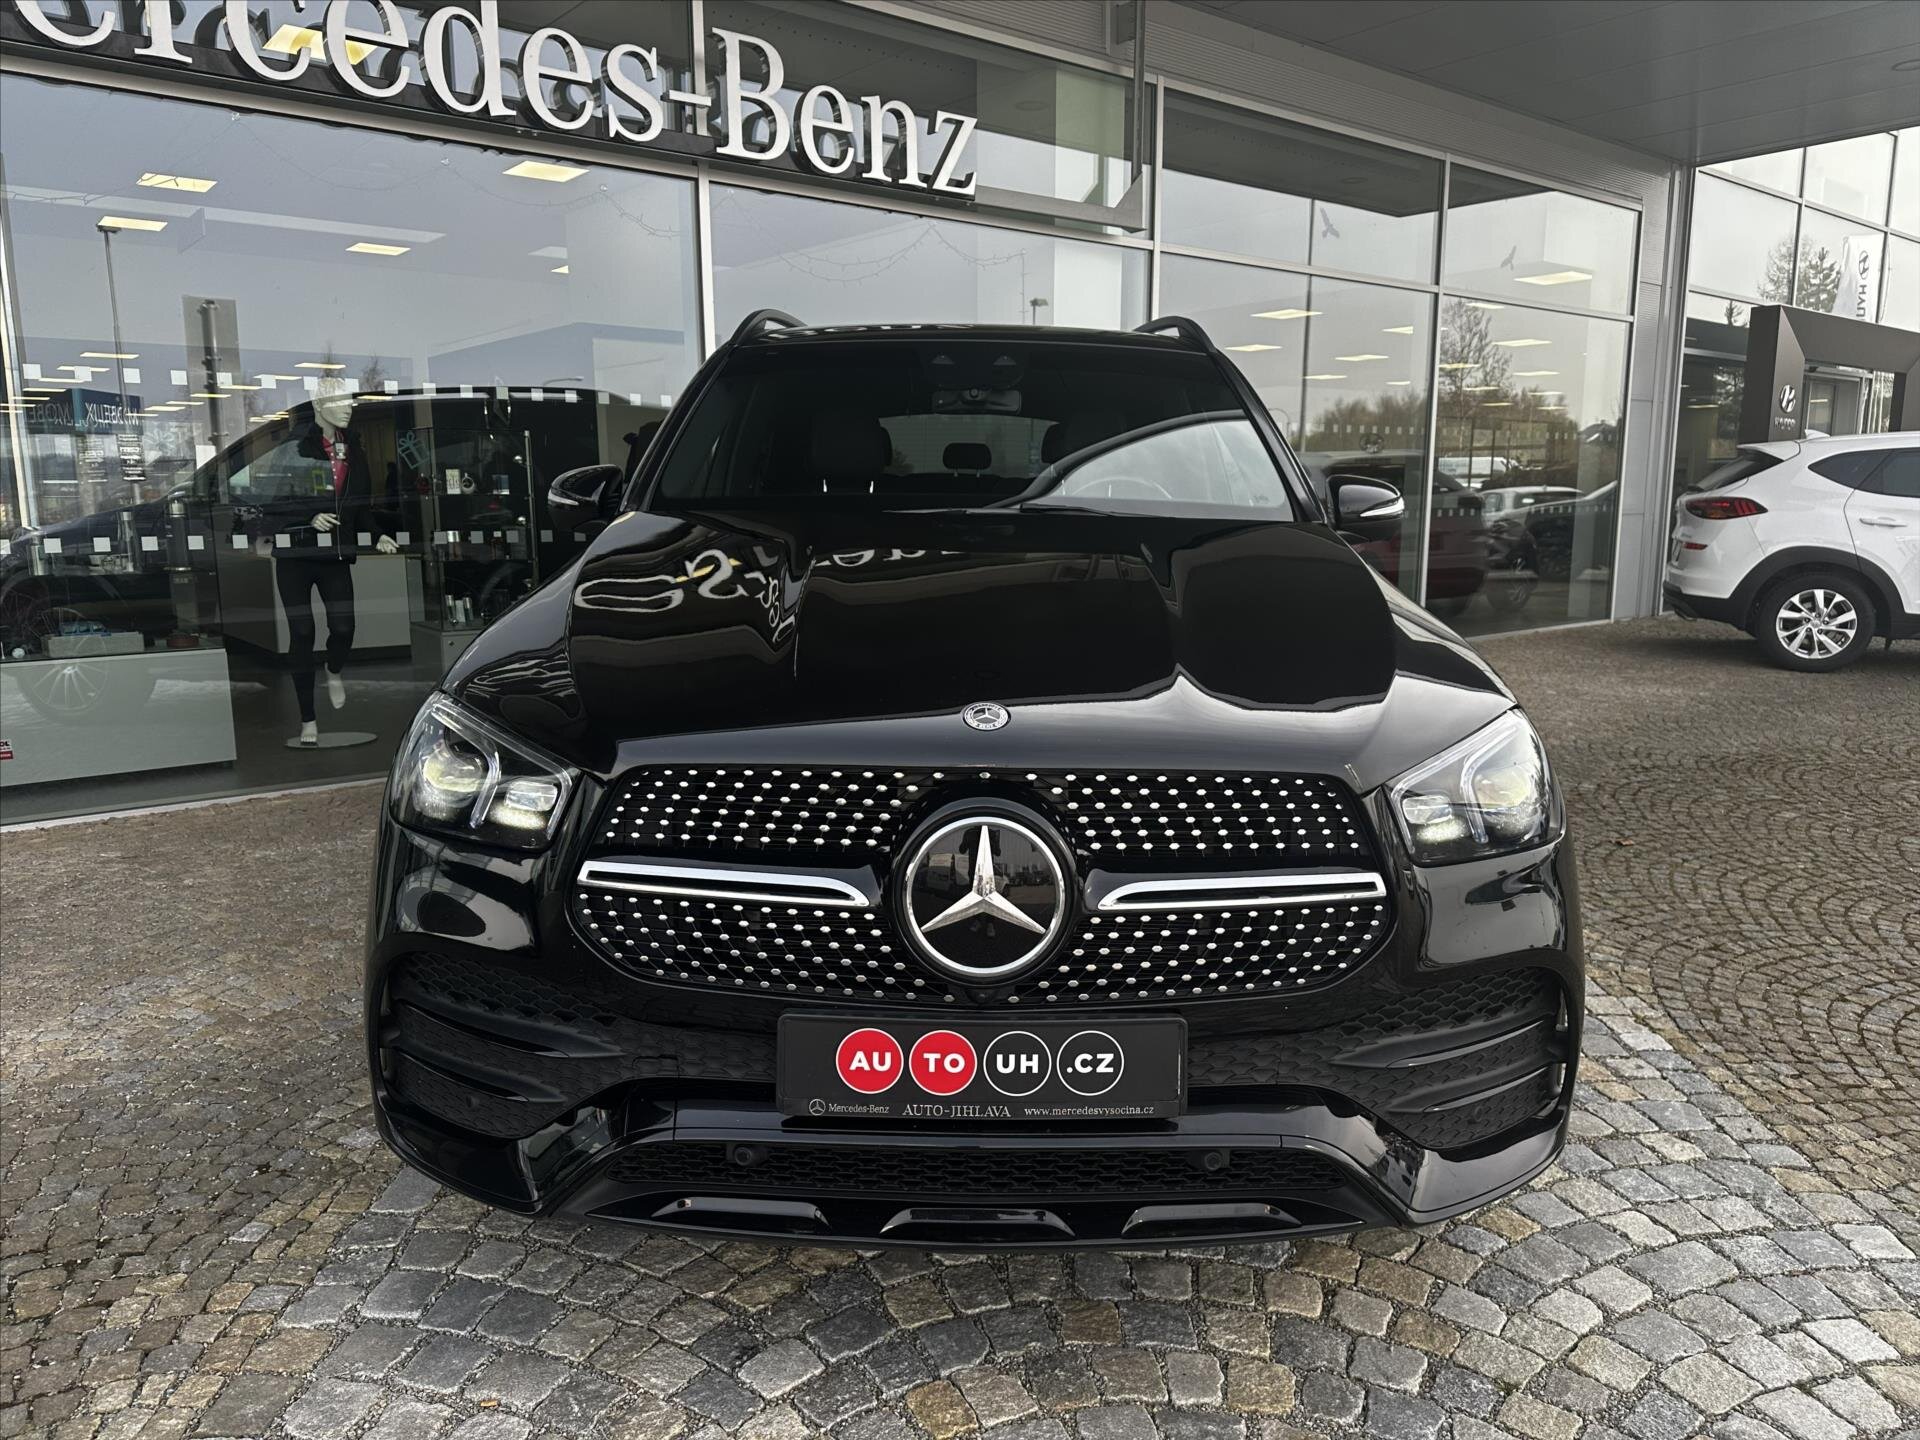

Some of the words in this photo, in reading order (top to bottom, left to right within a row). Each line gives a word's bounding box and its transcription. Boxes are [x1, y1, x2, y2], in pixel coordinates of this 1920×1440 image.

[849, 1050, 892, 1072] AU
[923, 1052, 966, 1073] TO
[995, 1053, 1039, 1074] UH
[1066, 1052, 1115, 1074] .CZ
[828, 1102, 890, 1114] Mercedes-Benz
[902, 1103, 1012, 1119] AUTO-JIHLAVA
[1024, 1105, 1154, 1117] www.mercedesvysocina.cz
